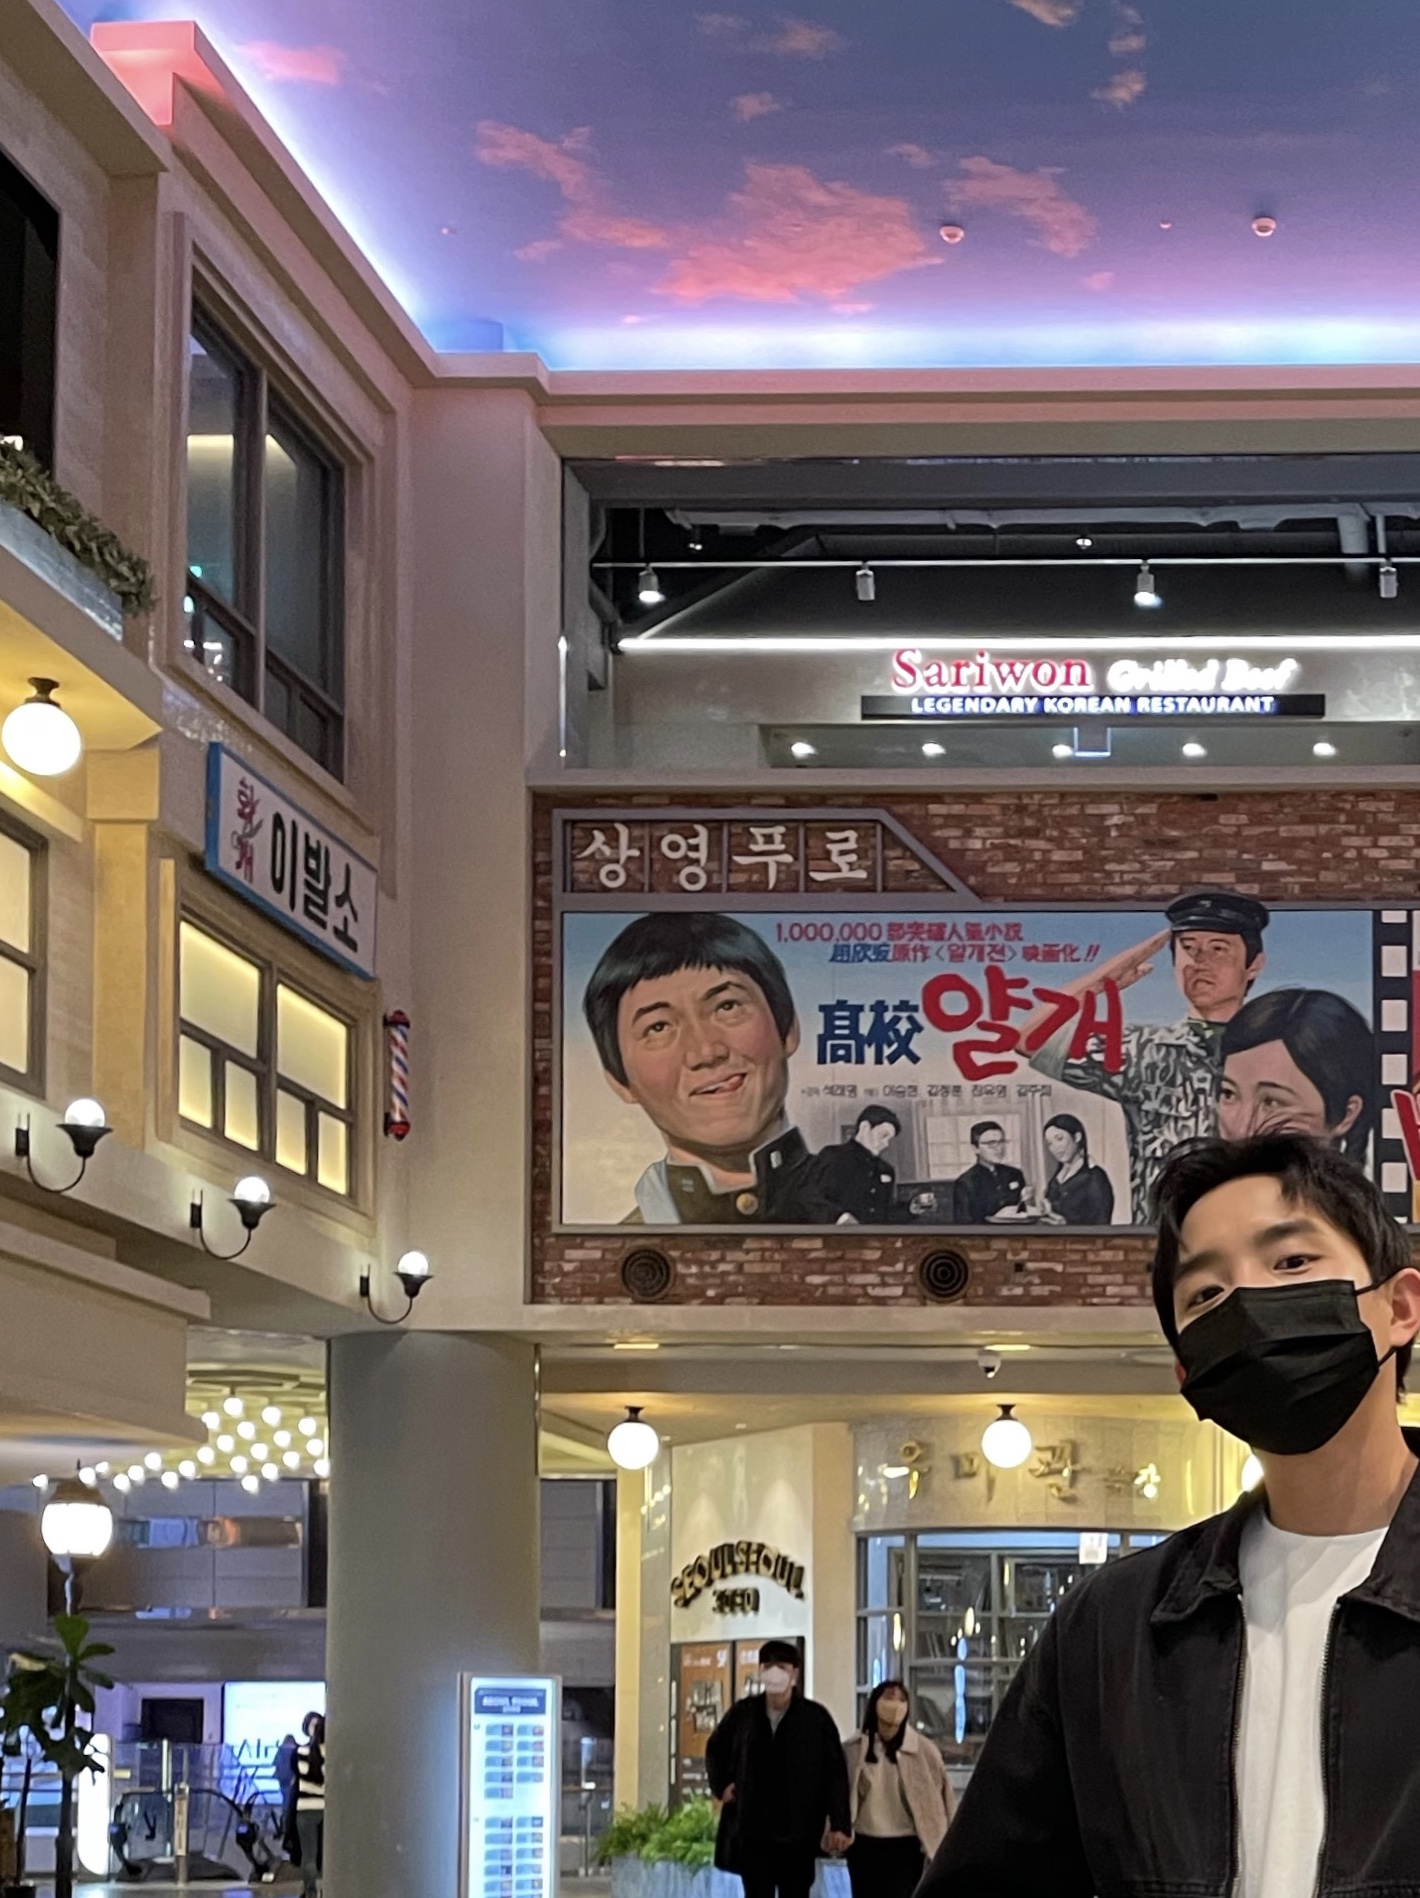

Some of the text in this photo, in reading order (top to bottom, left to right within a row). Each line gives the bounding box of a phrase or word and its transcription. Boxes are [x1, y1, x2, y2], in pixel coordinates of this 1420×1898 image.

[891, 648, 1094, 693] Sariwon
[911, 696, 1274, 714] LEGENDARY KOREAN RESTAURANT
[270, 811, 359, 953] 이발소
[921, 964, 1123, 1081] 얄개
